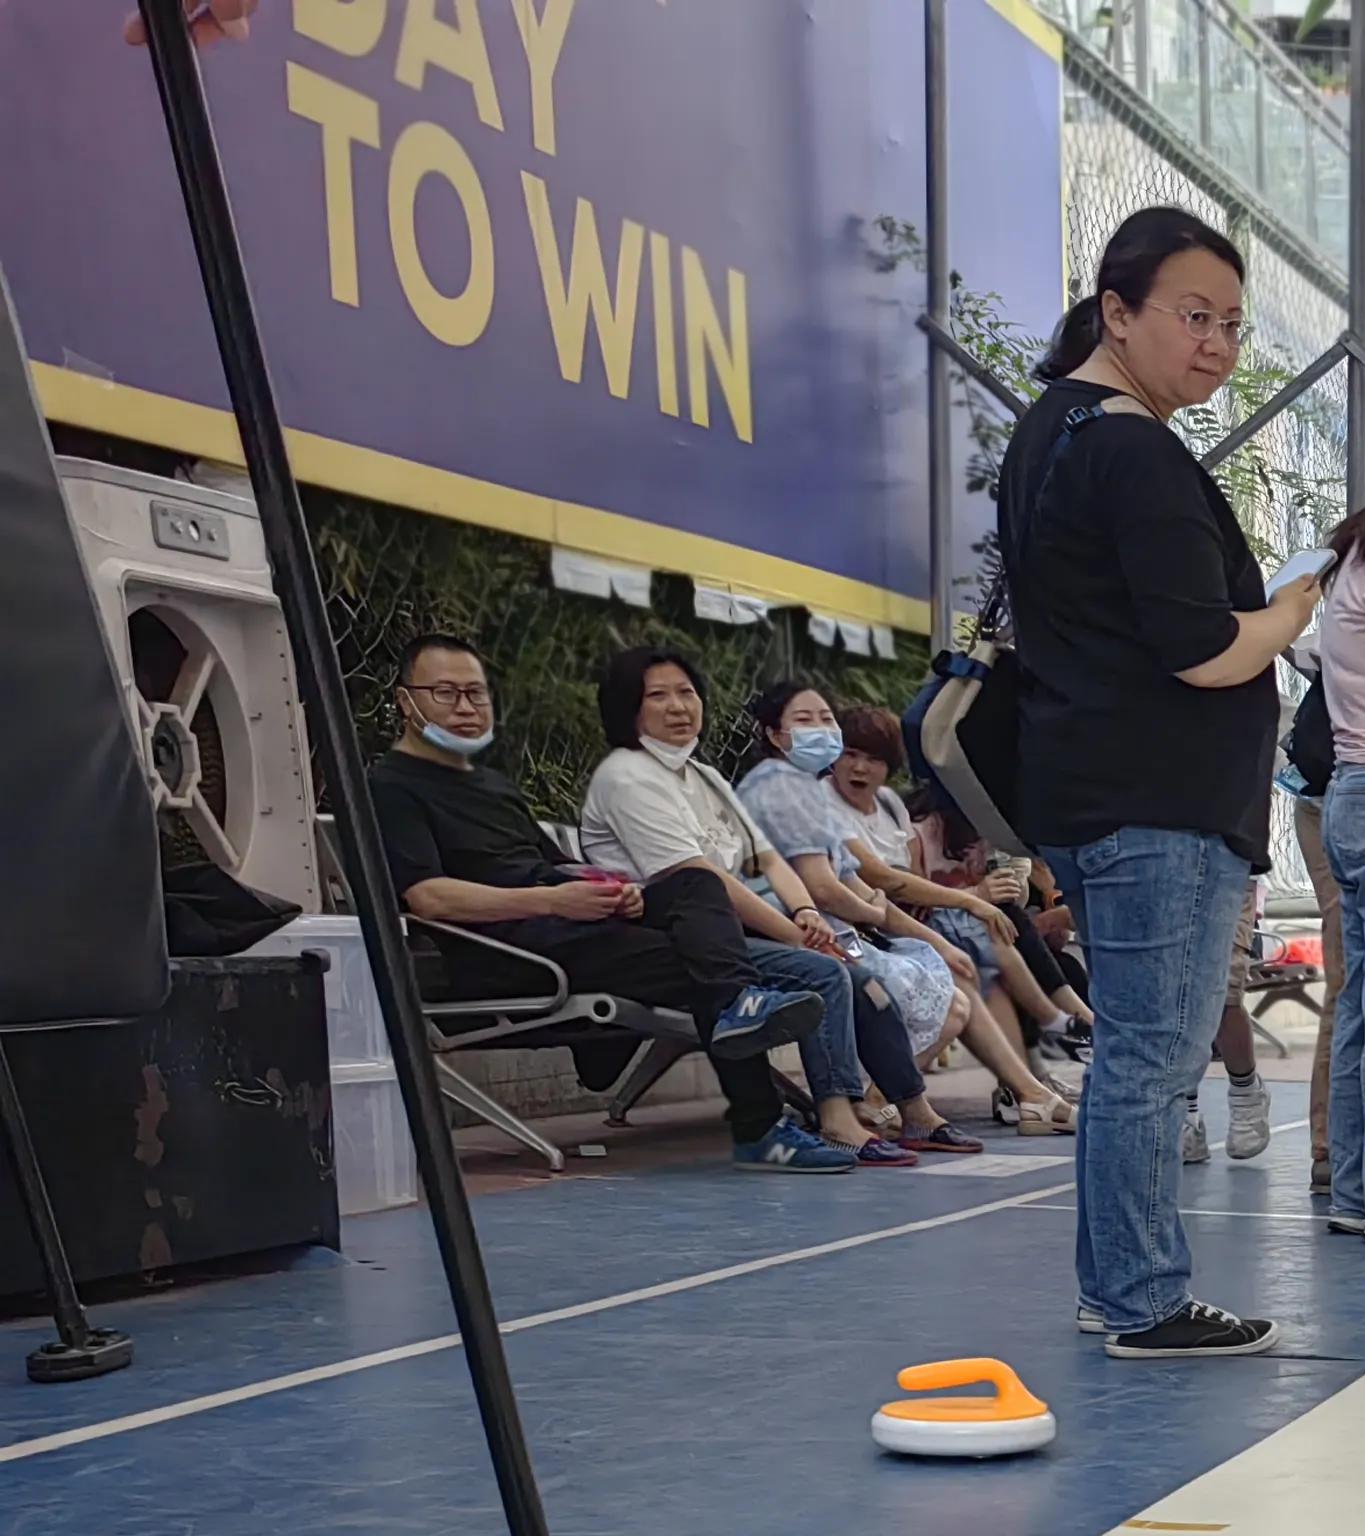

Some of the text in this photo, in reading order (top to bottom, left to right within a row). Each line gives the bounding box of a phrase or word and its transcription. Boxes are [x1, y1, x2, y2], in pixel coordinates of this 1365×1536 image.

[292, 0, 574, 157] AY
[286, 60, 753, 445] TO WIN
